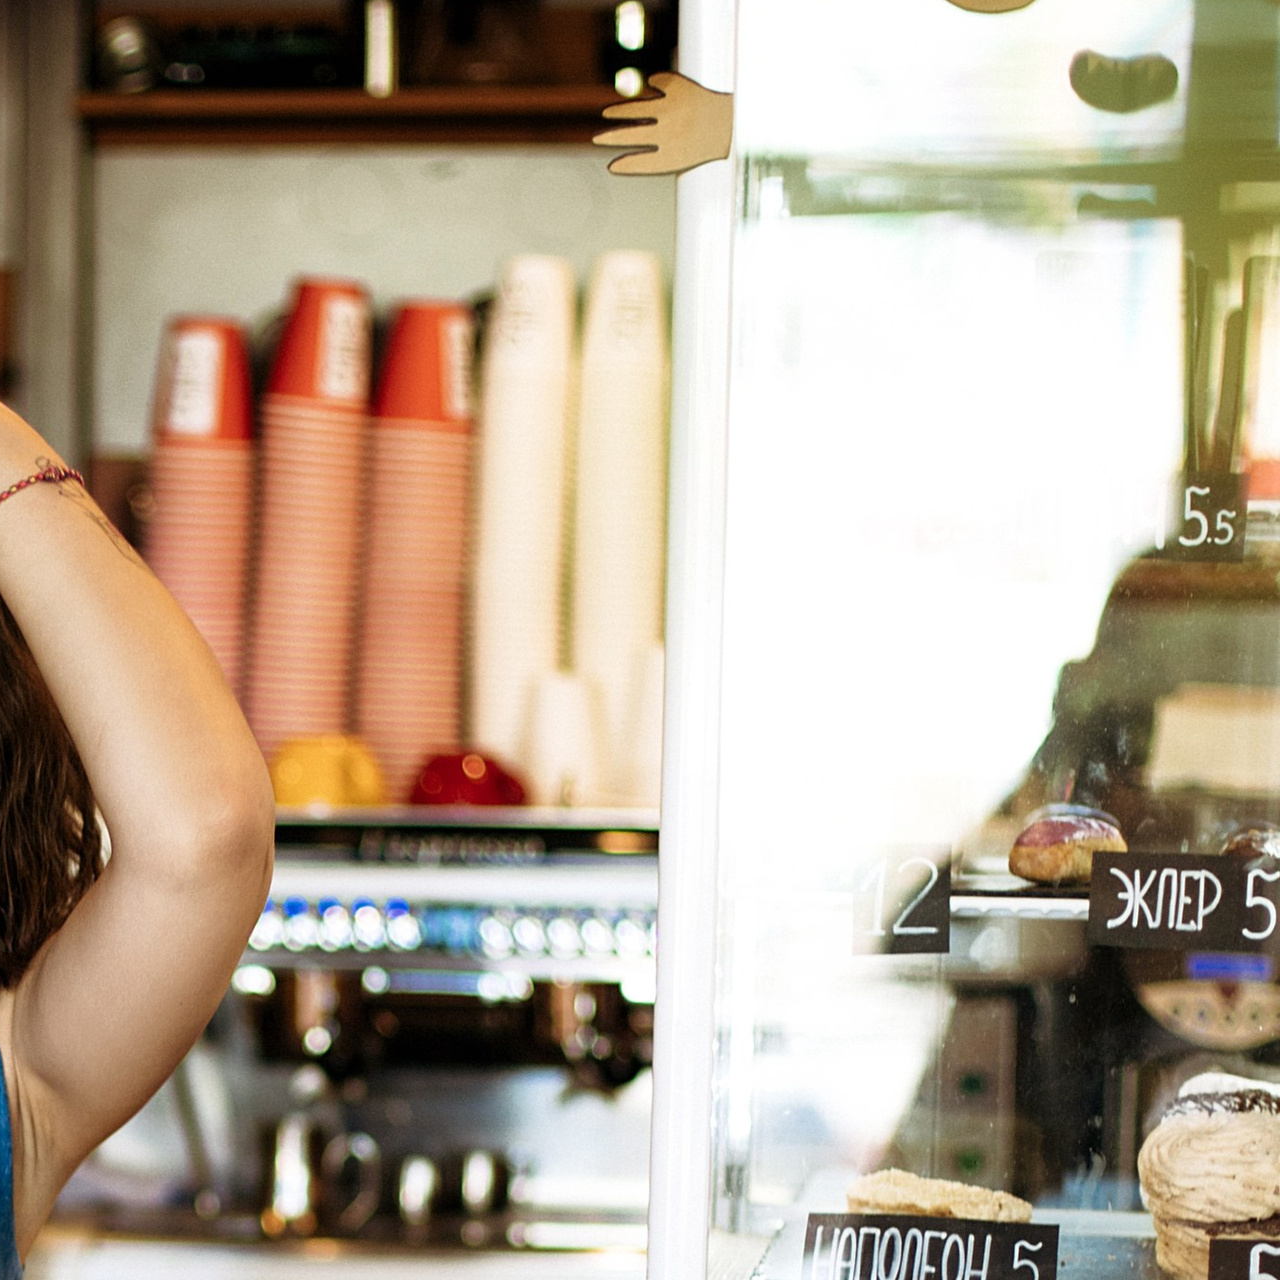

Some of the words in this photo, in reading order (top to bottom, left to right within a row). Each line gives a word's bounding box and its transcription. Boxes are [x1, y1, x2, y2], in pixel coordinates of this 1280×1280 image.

[1178, 485, 1237, 547] 5.5
[859, 857, 939, 936] 12
[1107, 867, 1222, 931] ЭКЛЕР
[1241, 868, 1280, 940] 5
